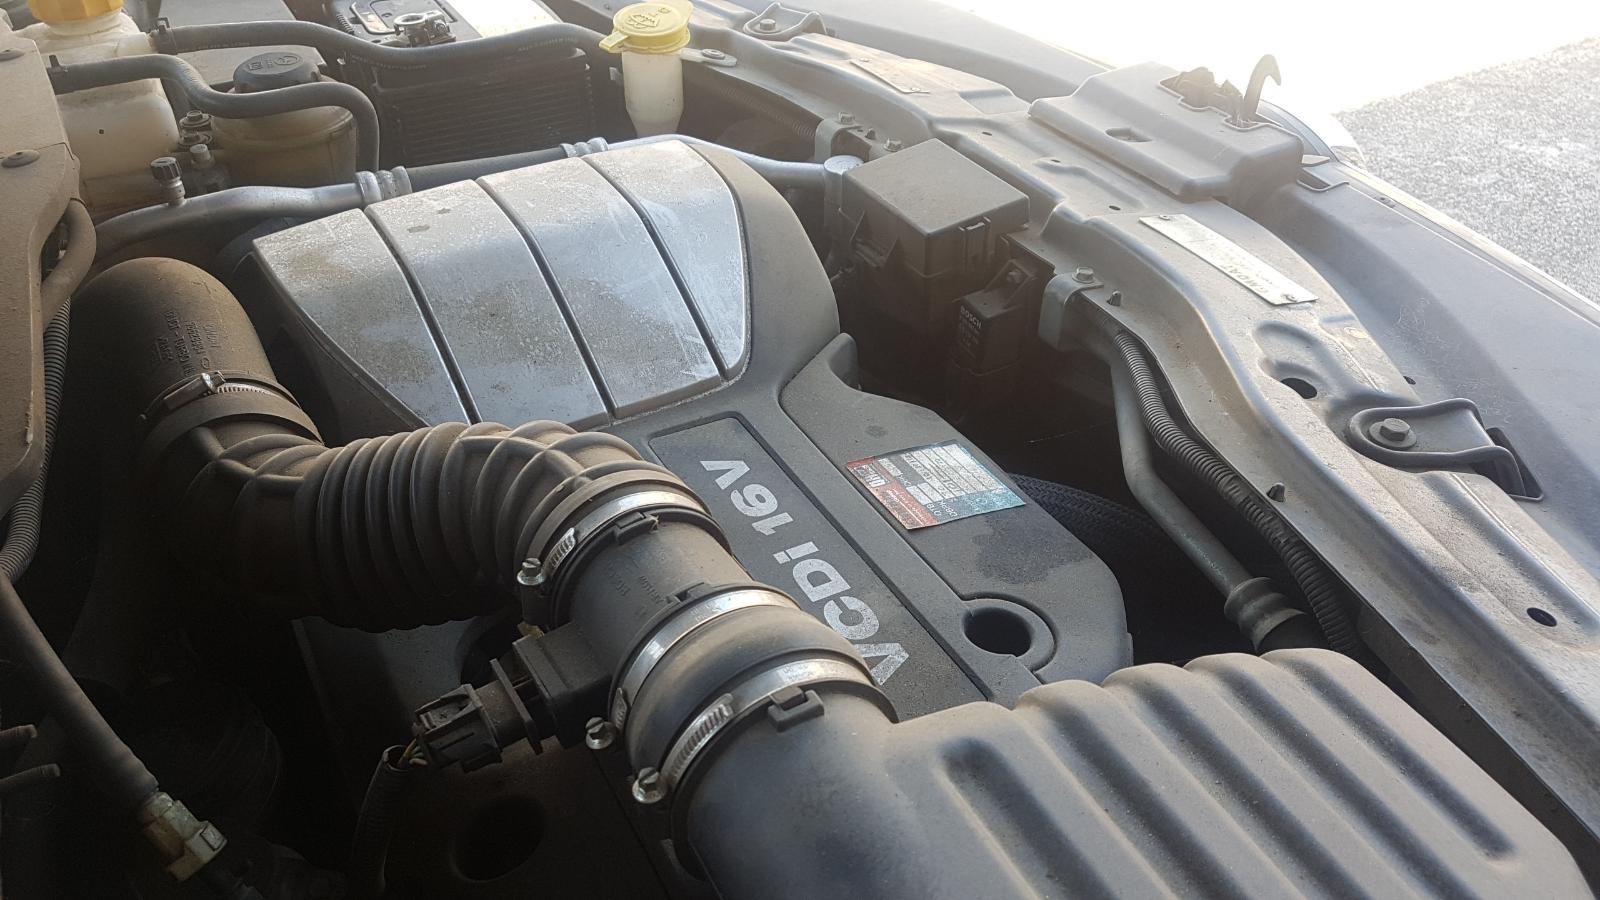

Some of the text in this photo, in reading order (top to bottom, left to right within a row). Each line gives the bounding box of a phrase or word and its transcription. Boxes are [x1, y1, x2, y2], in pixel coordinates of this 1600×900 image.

[960, 304, 983, 329] BOSCH
[699, 460, 794, 536] 16V
[772, 541, 909, 686] VCDi
